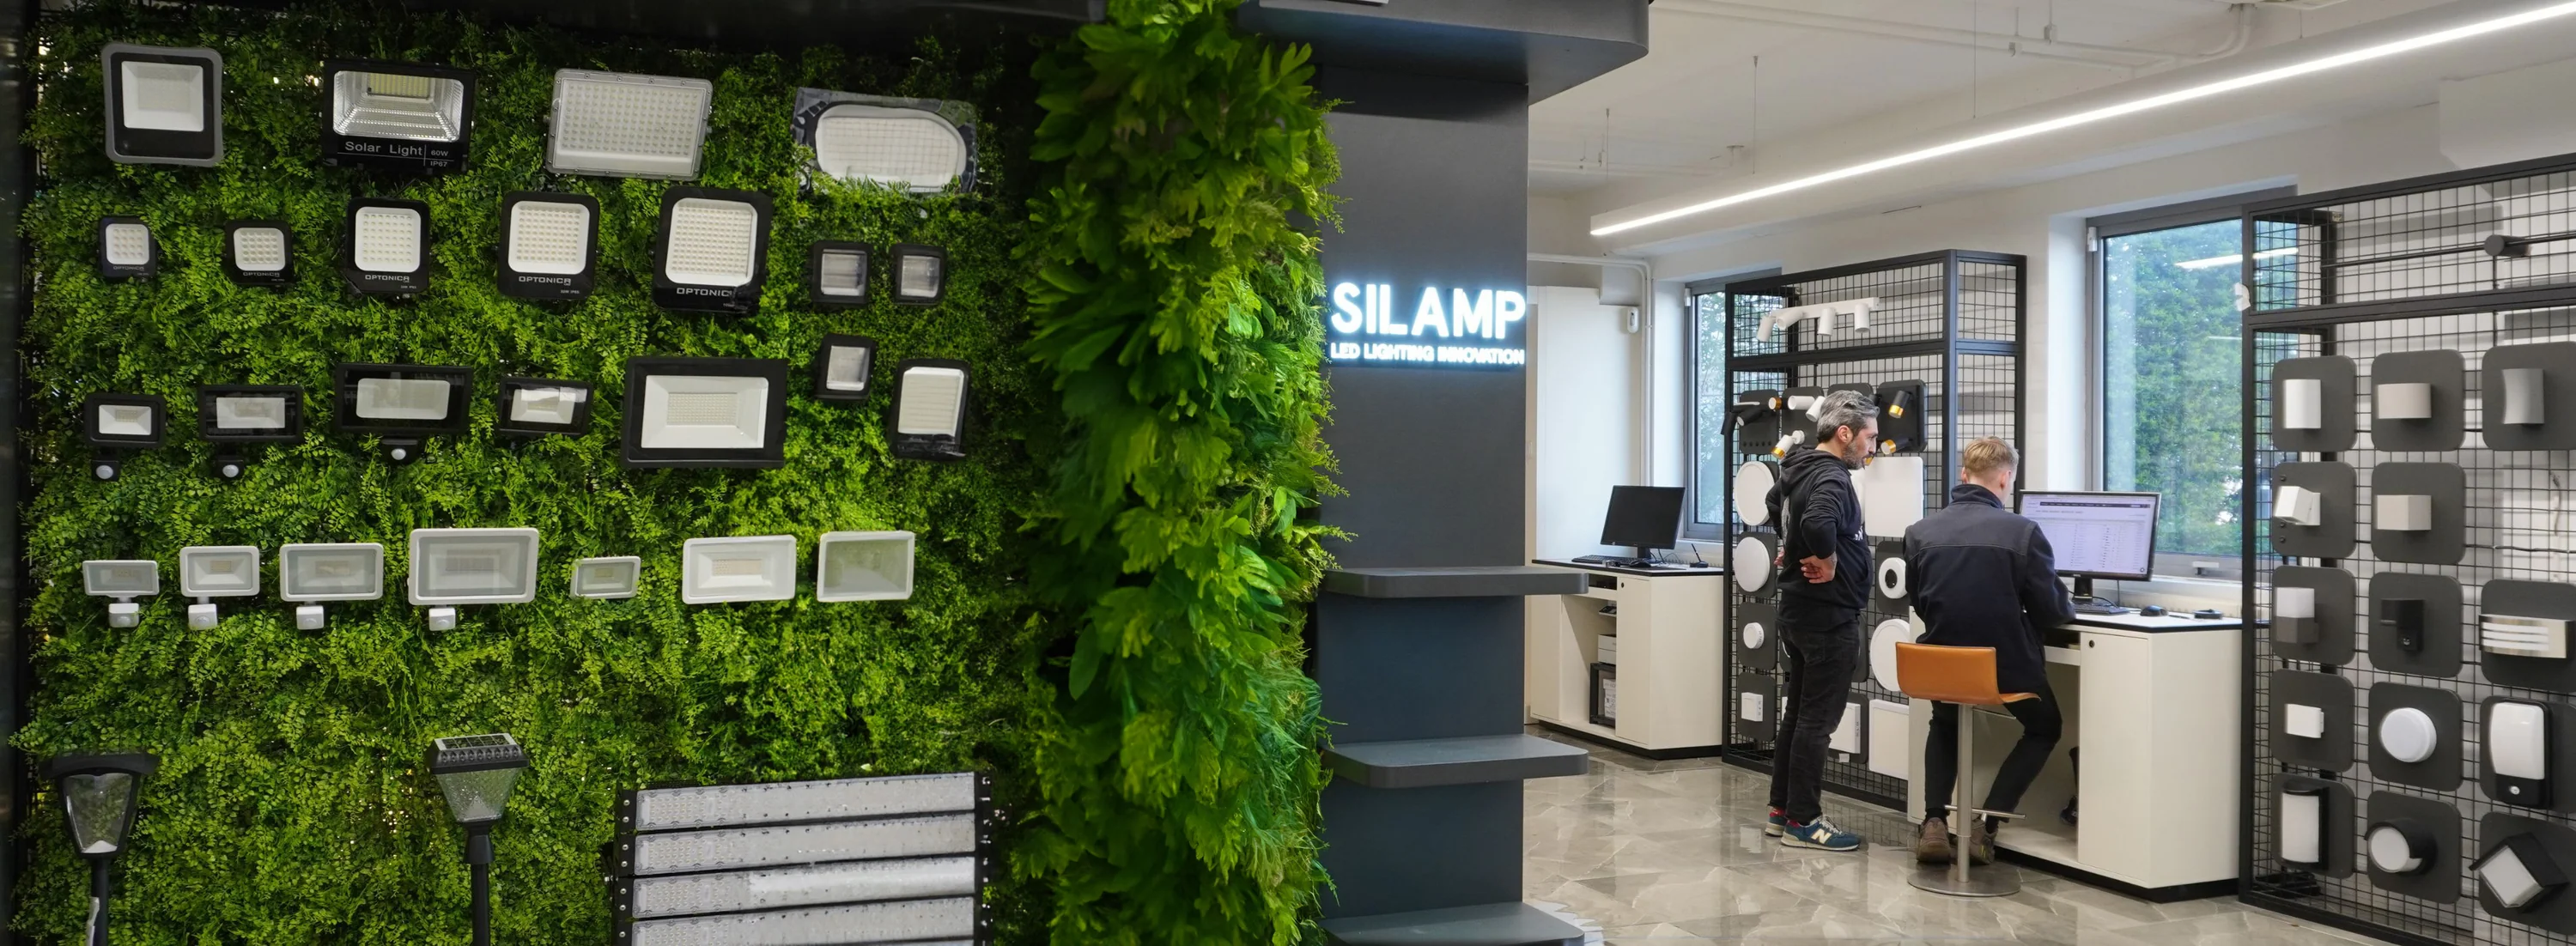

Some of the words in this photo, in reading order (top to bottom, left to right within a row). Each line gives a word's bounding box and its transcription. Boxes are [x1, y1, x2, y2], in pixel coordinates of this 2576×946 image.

[345, 141, 381, 153] Solar
[389, 144, 423, 157] Light
[1331, 282, 1527, 340] SILAMP
[1331, 343, 1360, 359] LED
[1364, 343, 1435, 362] LIGHTING
[1437, 346, 1525, 365] INNOVATION
